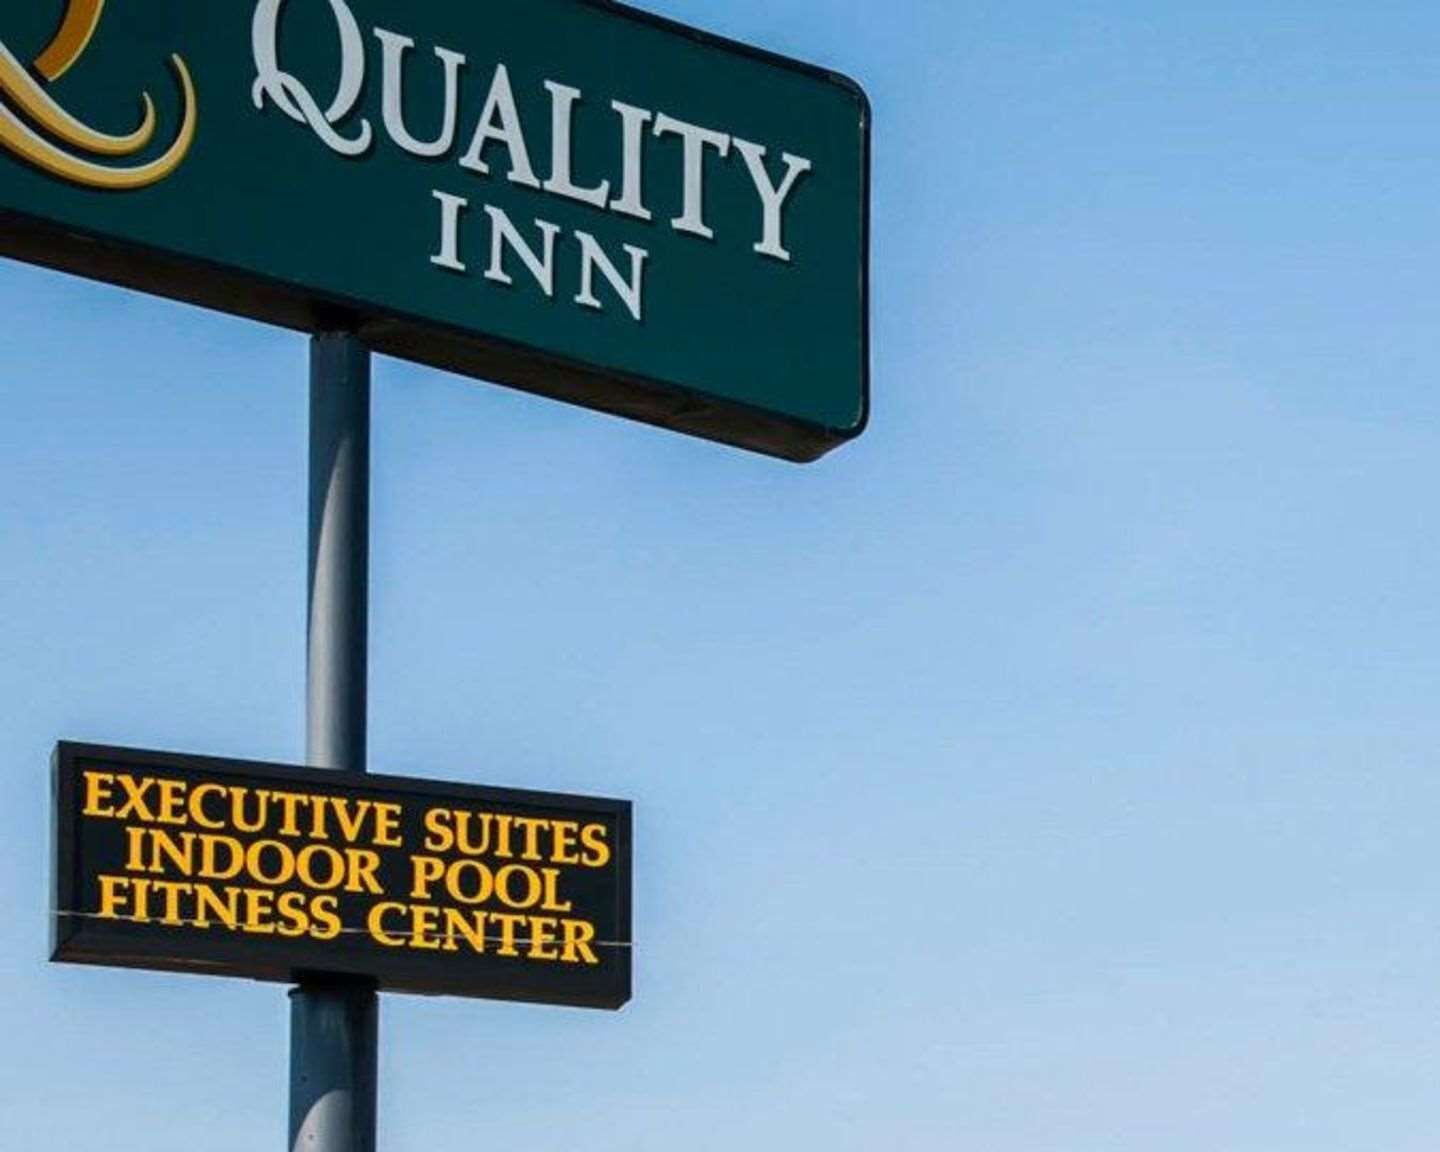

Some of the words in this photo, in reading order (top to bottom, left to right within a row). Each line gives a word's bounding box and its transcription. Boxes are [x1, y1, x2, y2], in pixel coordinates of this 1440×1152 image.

[251, 0, 811, 261] QUALITY
[430, 189, 647, 320] INN
[82, 771, 402, 847] EXECUTIVE
[423, 808, 611, 867] SUITES
[125, 827, 384, 894] INDOOR
[410, 855, 571, 912] POOL
[97, 874, 342, 939] FITNESS
[367, 902, 598, 963] CENTER
